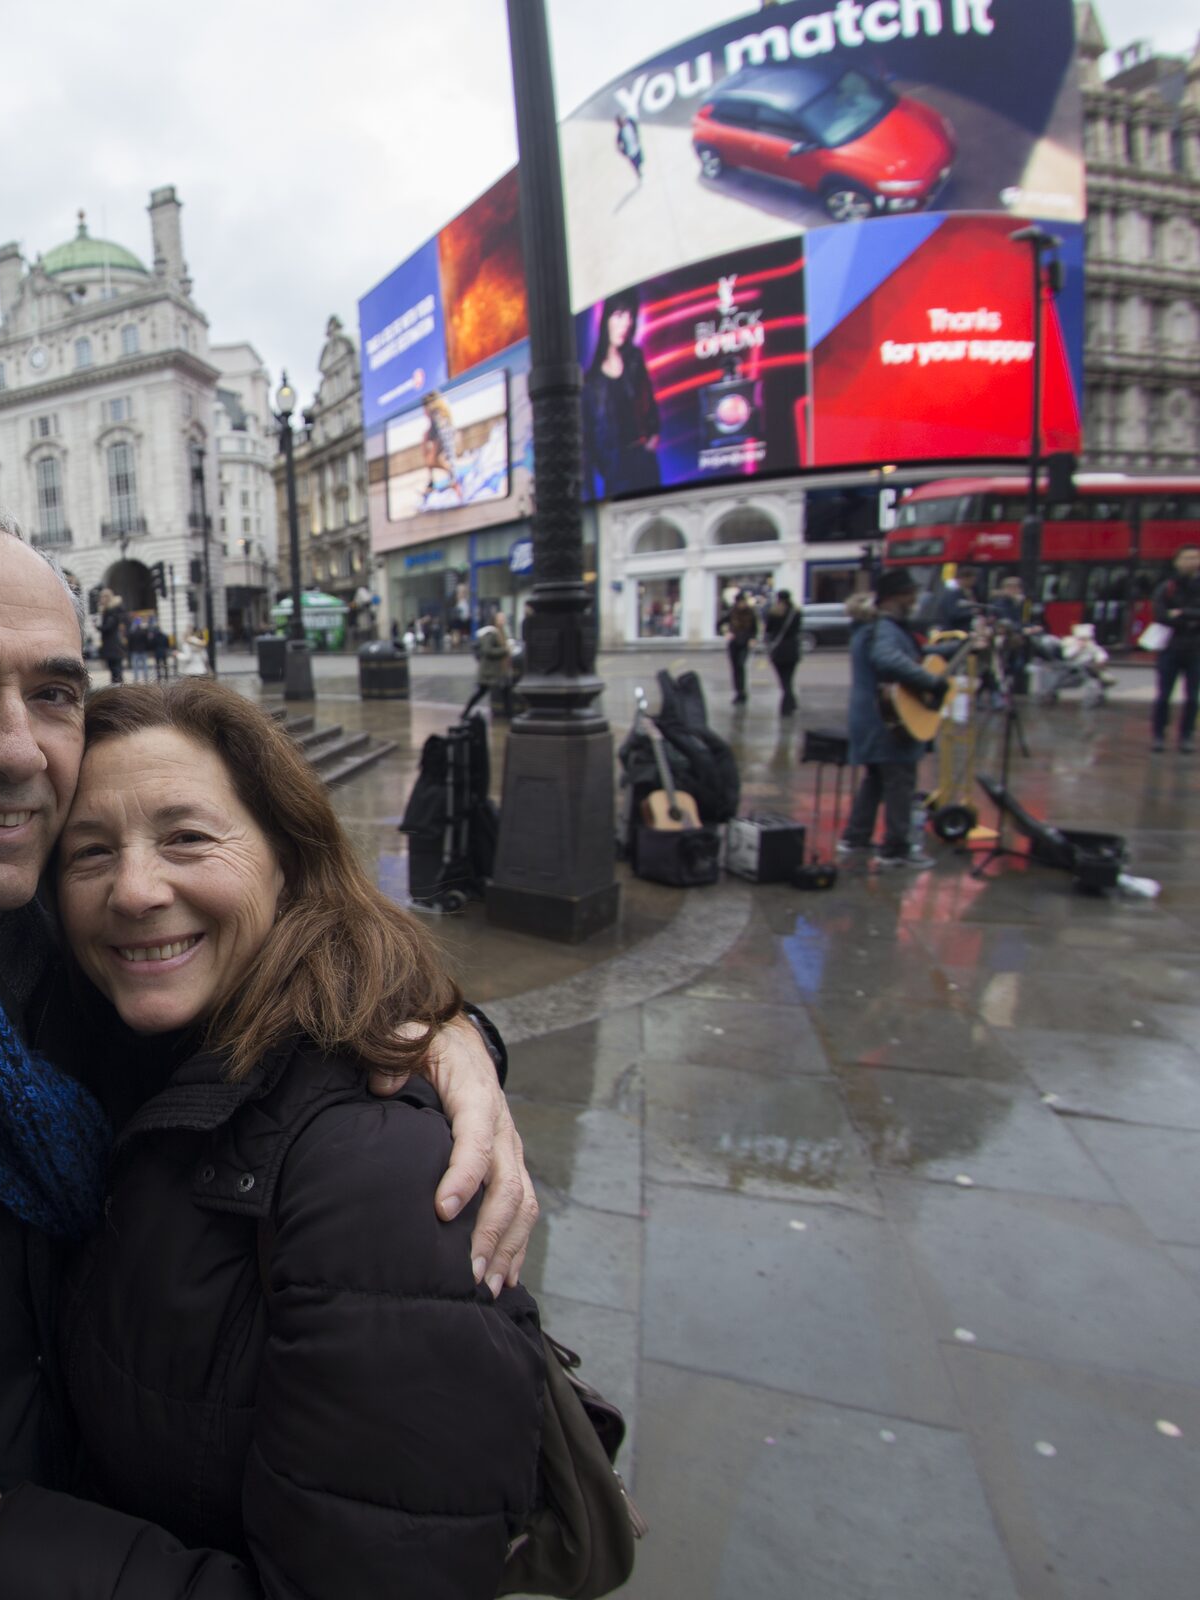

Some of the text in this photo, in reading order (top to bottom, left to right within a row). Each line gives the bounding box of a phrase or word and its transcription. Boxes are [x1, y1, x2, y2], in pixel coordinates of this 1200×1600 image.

[613, 50, 714, 119] You
[723, 0, 942, 74] match
[695, 309, 763, 342] BLACK
[928, 307, 1002, 333] Thanks
[694, 322, 765, 359] OPIUM
[880, 339, 1035, 367] for your suppor
